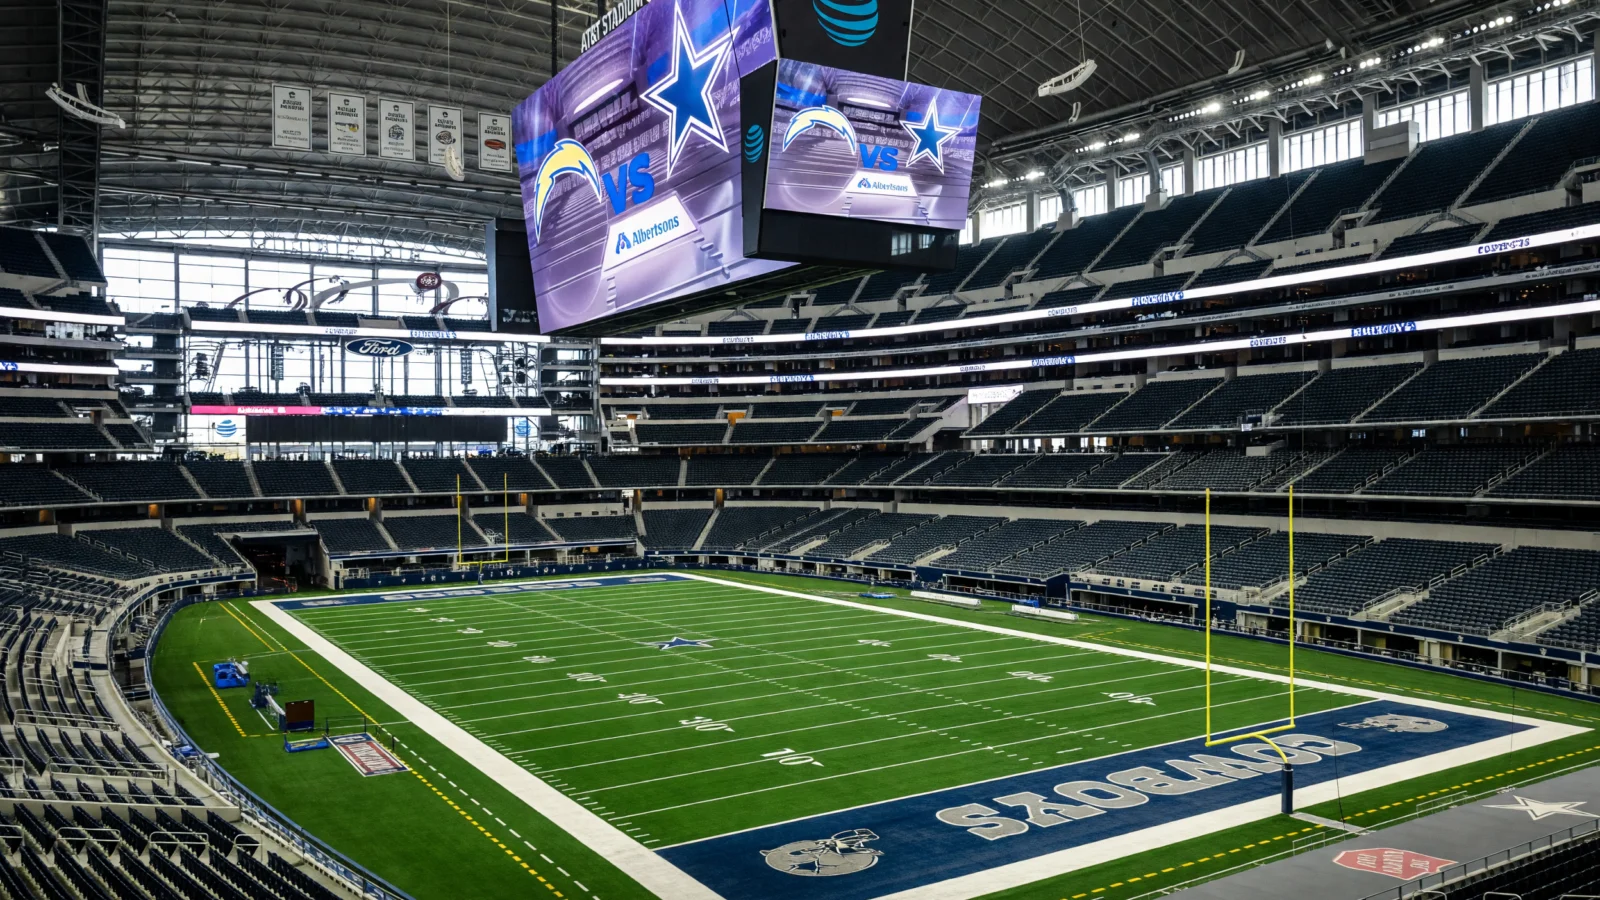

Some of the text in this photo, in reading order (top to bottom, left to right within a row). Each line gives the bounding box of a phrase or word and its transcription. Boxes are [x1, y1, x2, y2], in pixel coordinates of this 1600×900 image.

[581, 20, 600, 53] AT&T
[858, 143, 899, 171] VS
[602, 152, 654, 215] VS
[632, 216, 680, 246] Albertsons
[359, 340, 400, 355] Ford
[760, 748, 814, 765] 10
[936, 734, 1363, 841] COWBOYS
